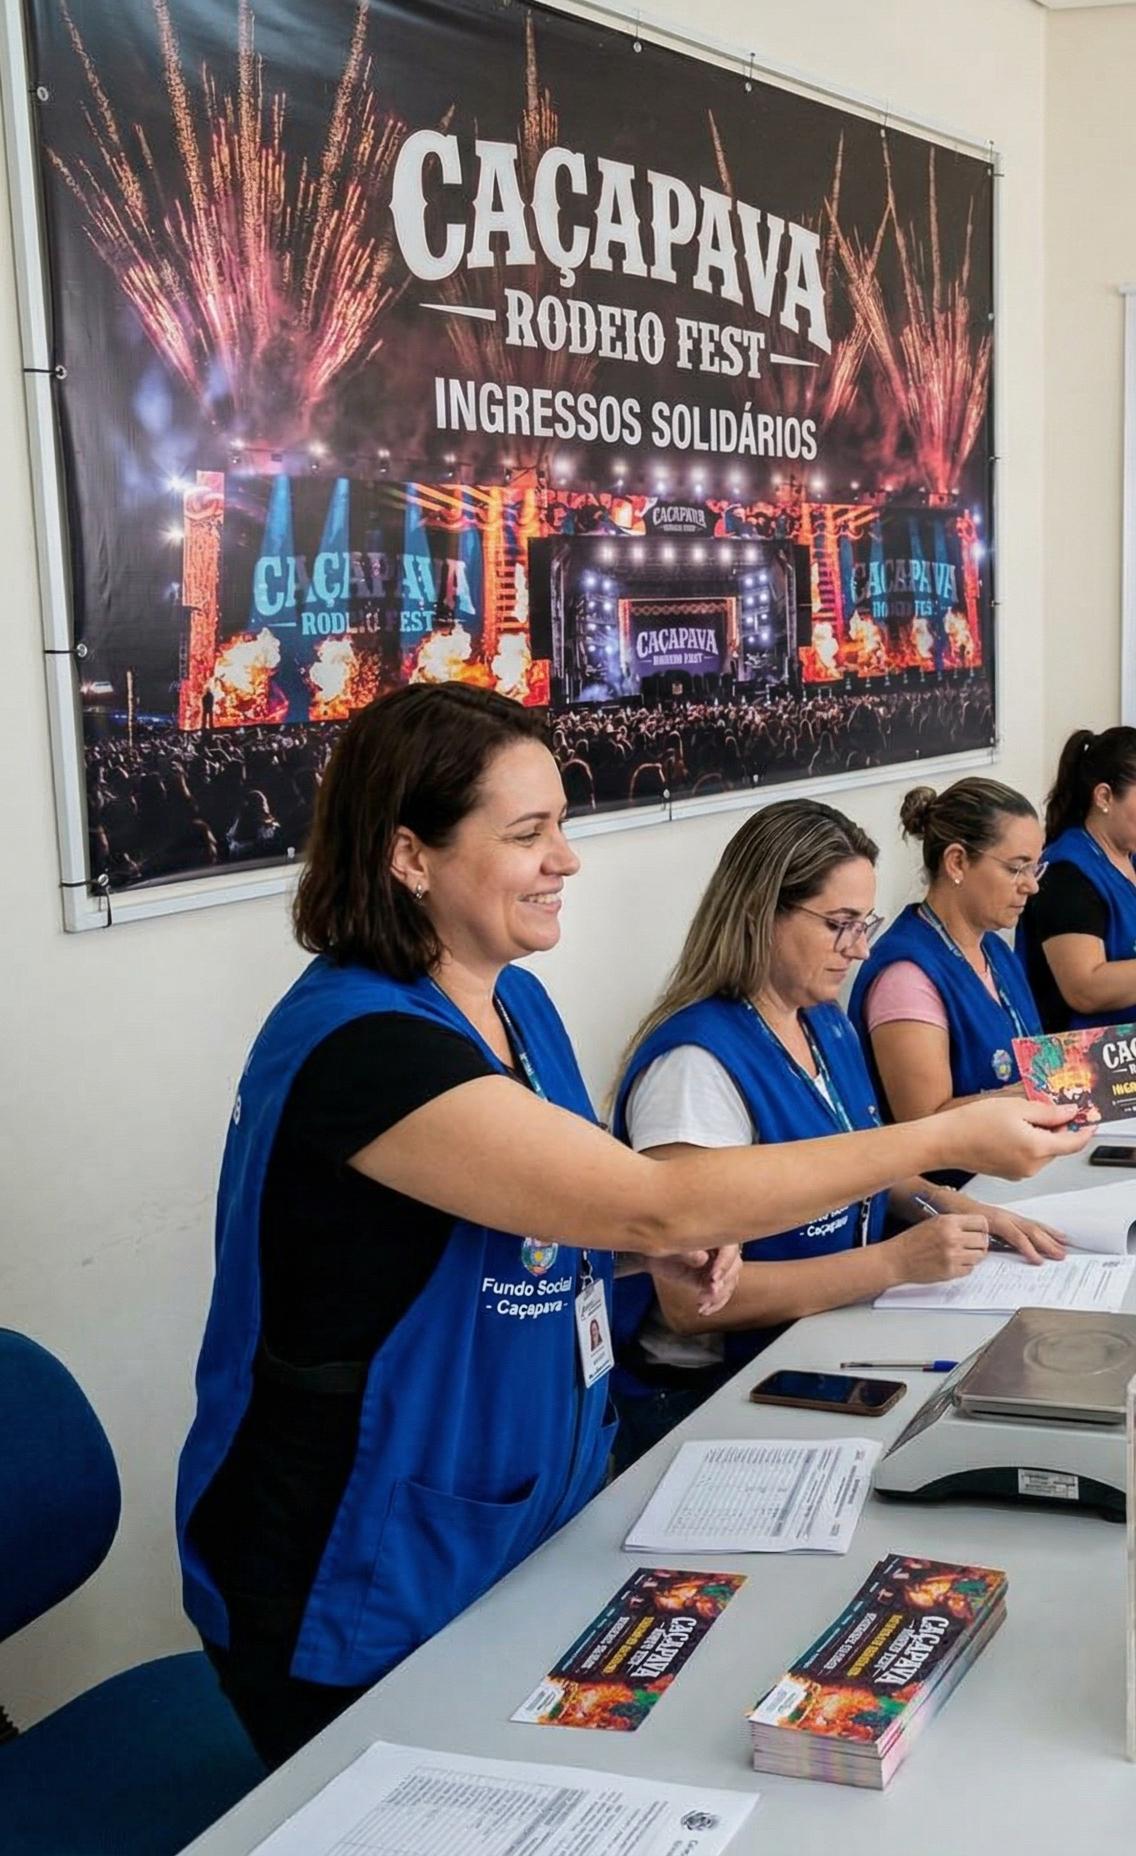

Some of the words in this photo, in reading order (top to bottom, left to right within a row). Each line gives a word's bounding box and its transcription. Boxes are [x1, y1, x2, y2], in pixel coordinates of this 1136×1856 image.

[390, 130, 831, 355] CAÇAPAVA
[504, 288, 665, 365] RODEIO
[676, 317, 765, 378] FEST
[435, 377, 642, 445] INGRESSOS
[652, 402, 817, 460] SOLIDÁRIOS
[482, 1277, 534, 1296] Fundo
[537, 1276, 573, 1296] Social
[497, 1300, 562, 1319] Caçapava
